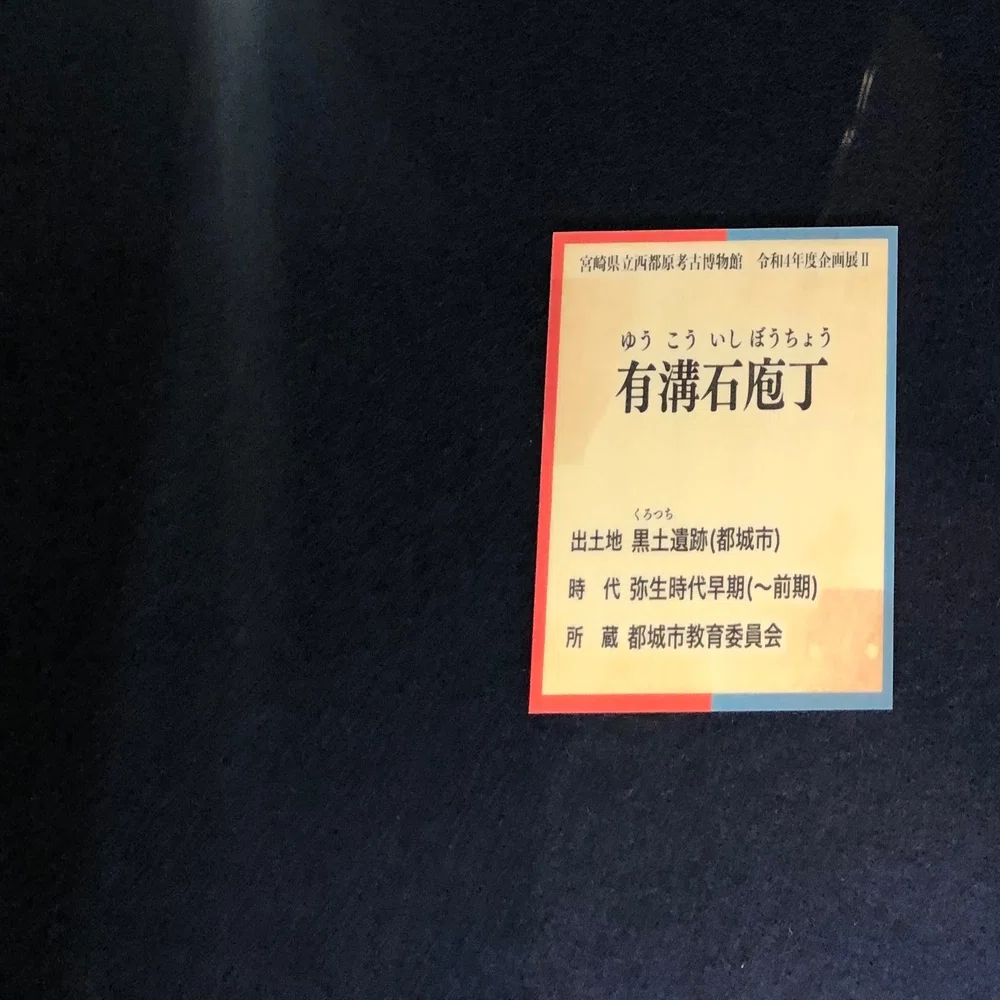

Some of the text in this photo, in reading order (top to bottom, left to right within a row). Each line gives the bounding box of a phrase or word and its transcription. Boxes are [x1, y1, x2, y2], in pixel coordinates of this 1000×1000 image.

[579, 253, 743, 272] 宮崎県立西都原考古博物館
[621, 330, 651, 350] ゆう
[667, 329, 695, 349] こう
[615, 357, 828, 414] 有溝石庖丁
[633, 508, 674, 521] くろつち
[571, 526, 781, 553] 出土地 黒土遺跡(都城市)
[628, 623, 782, 650] 都城市教育委員会
